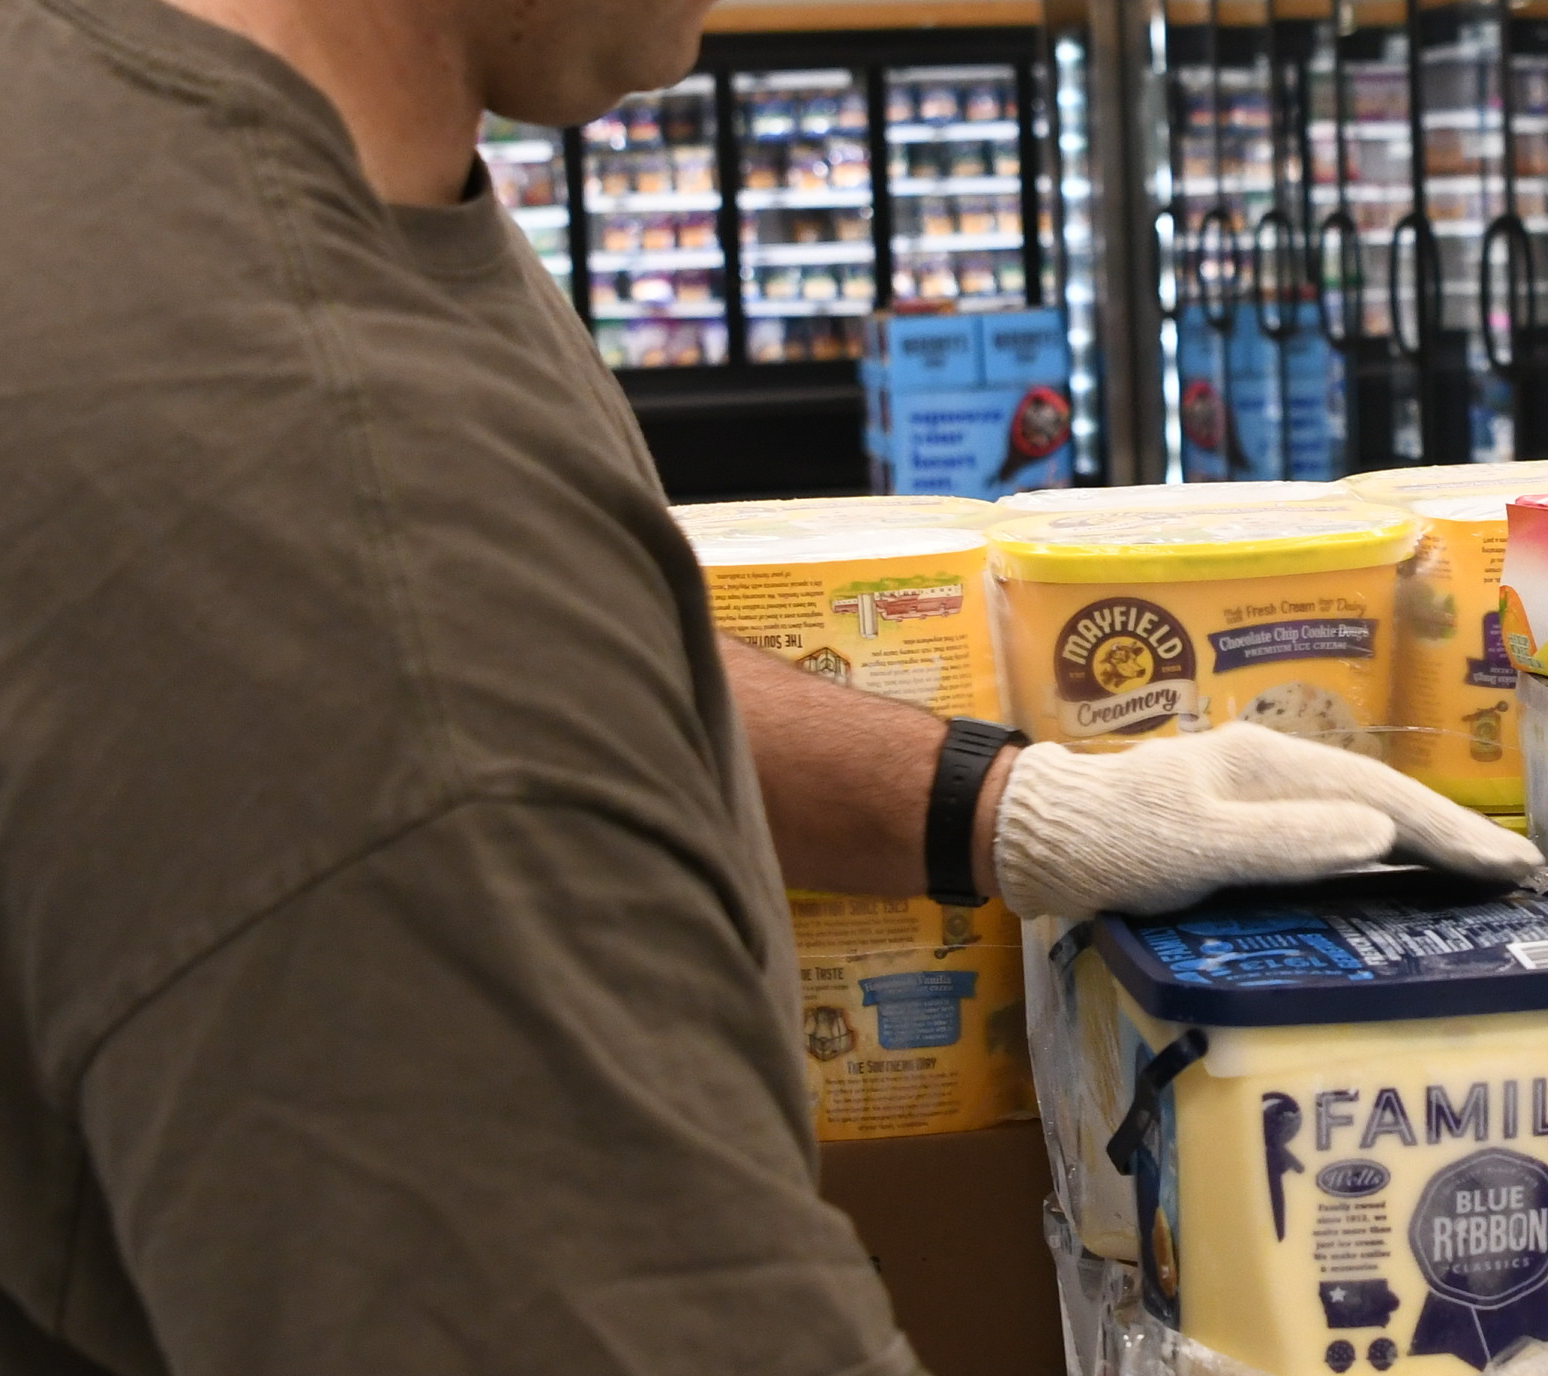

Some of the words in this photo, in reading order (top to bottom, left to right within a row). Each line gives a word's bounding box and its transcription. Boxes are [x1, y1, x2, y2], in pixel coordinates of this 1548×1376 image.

[1246, 604, 1276, 618] Fresh
[1281, 601, 1315, 614] Cream
[786, 635, 803, 648] THE
[1063, 606, 1183, 665] MAYFIELD
[1219, 630, 1272, 651] Chocolate
[1274, 628, 1298, 643] Chip
[1302, 625, 1334, 639] Cookie
[1244, 644, 1291, 658] PREMIUM
[1078, 688, 1181, 726] Creamery
[1456, 1186, 1524, 1214] BLUE
[1433, 1208, 1548, 1262] RIBBON
[1453, 1258, 1530, 1274] CLASSICS
